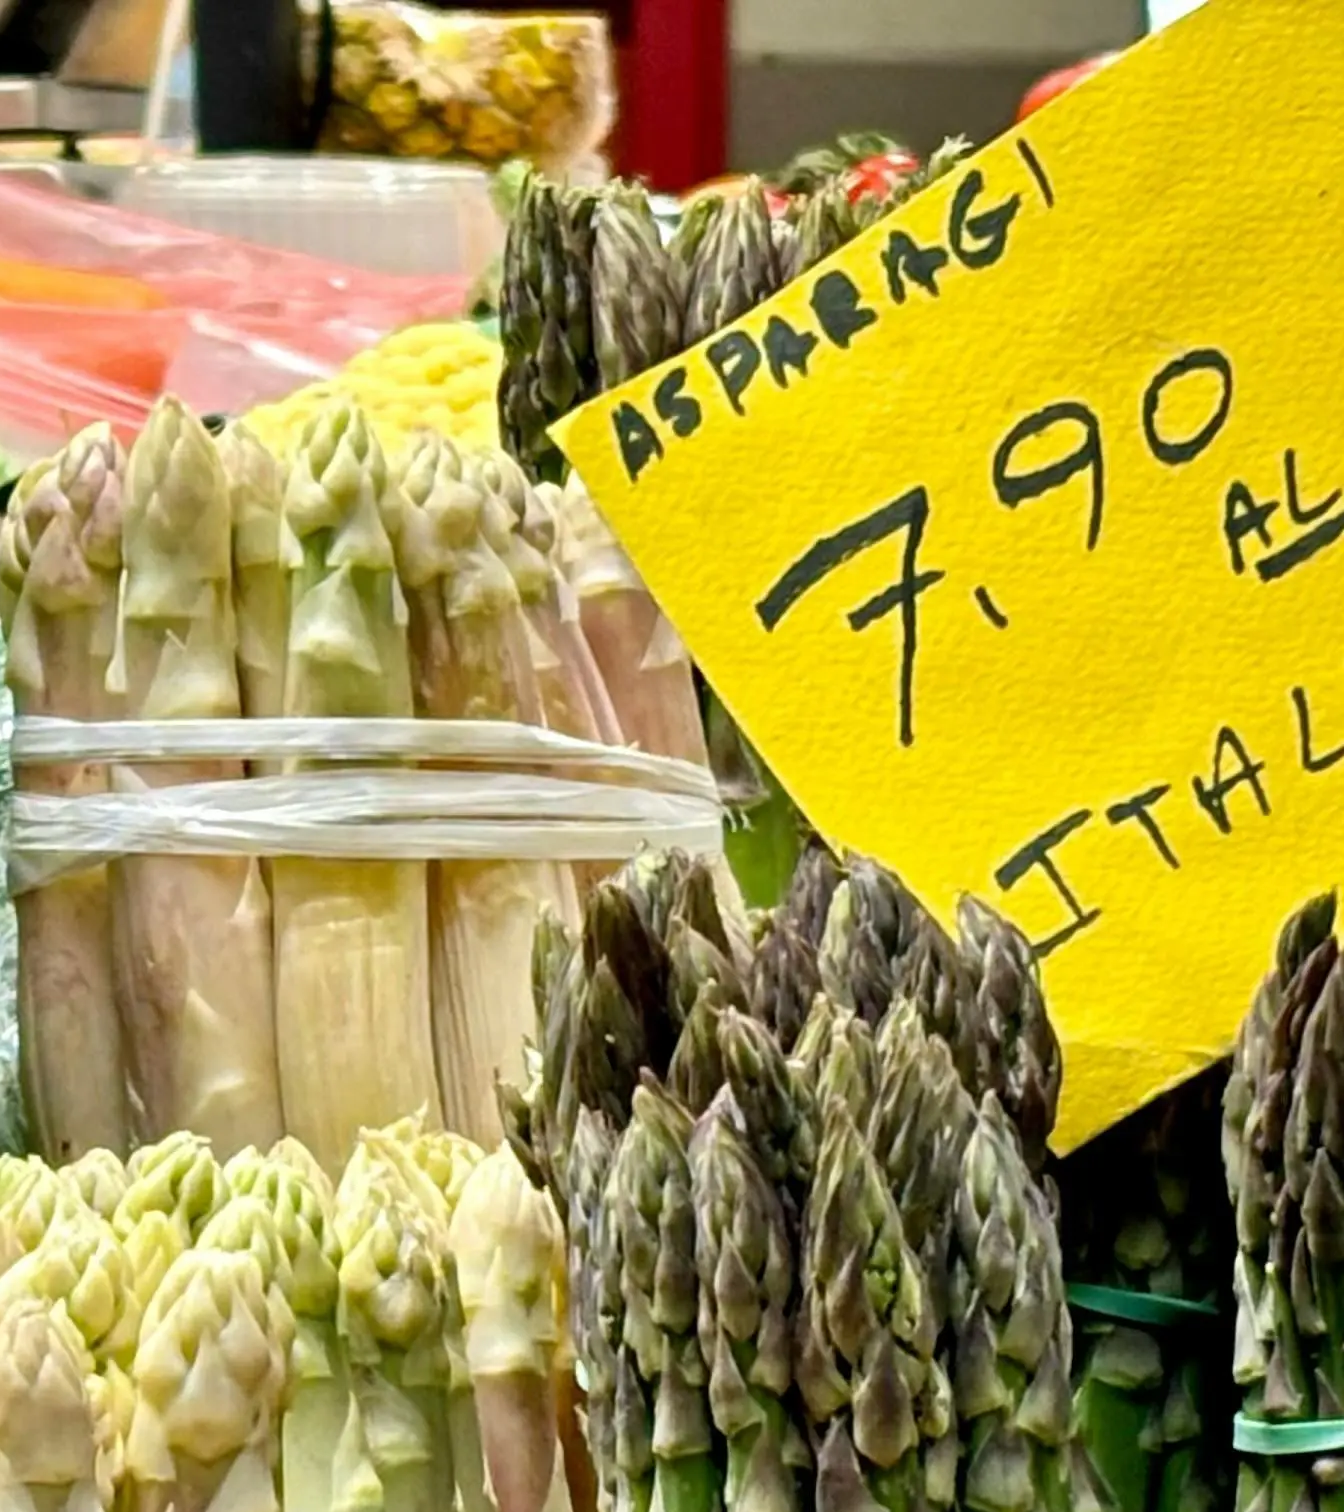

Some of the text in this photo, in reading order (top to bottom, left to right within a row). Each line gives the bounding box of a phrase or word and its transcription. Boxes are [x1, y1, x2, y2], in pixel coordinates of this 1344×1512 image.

[610, 138, 1053, 483] ASPARAGI
[754, 346, 1234, 748] 7,90
[1222, 447, 1343, 575] AL
